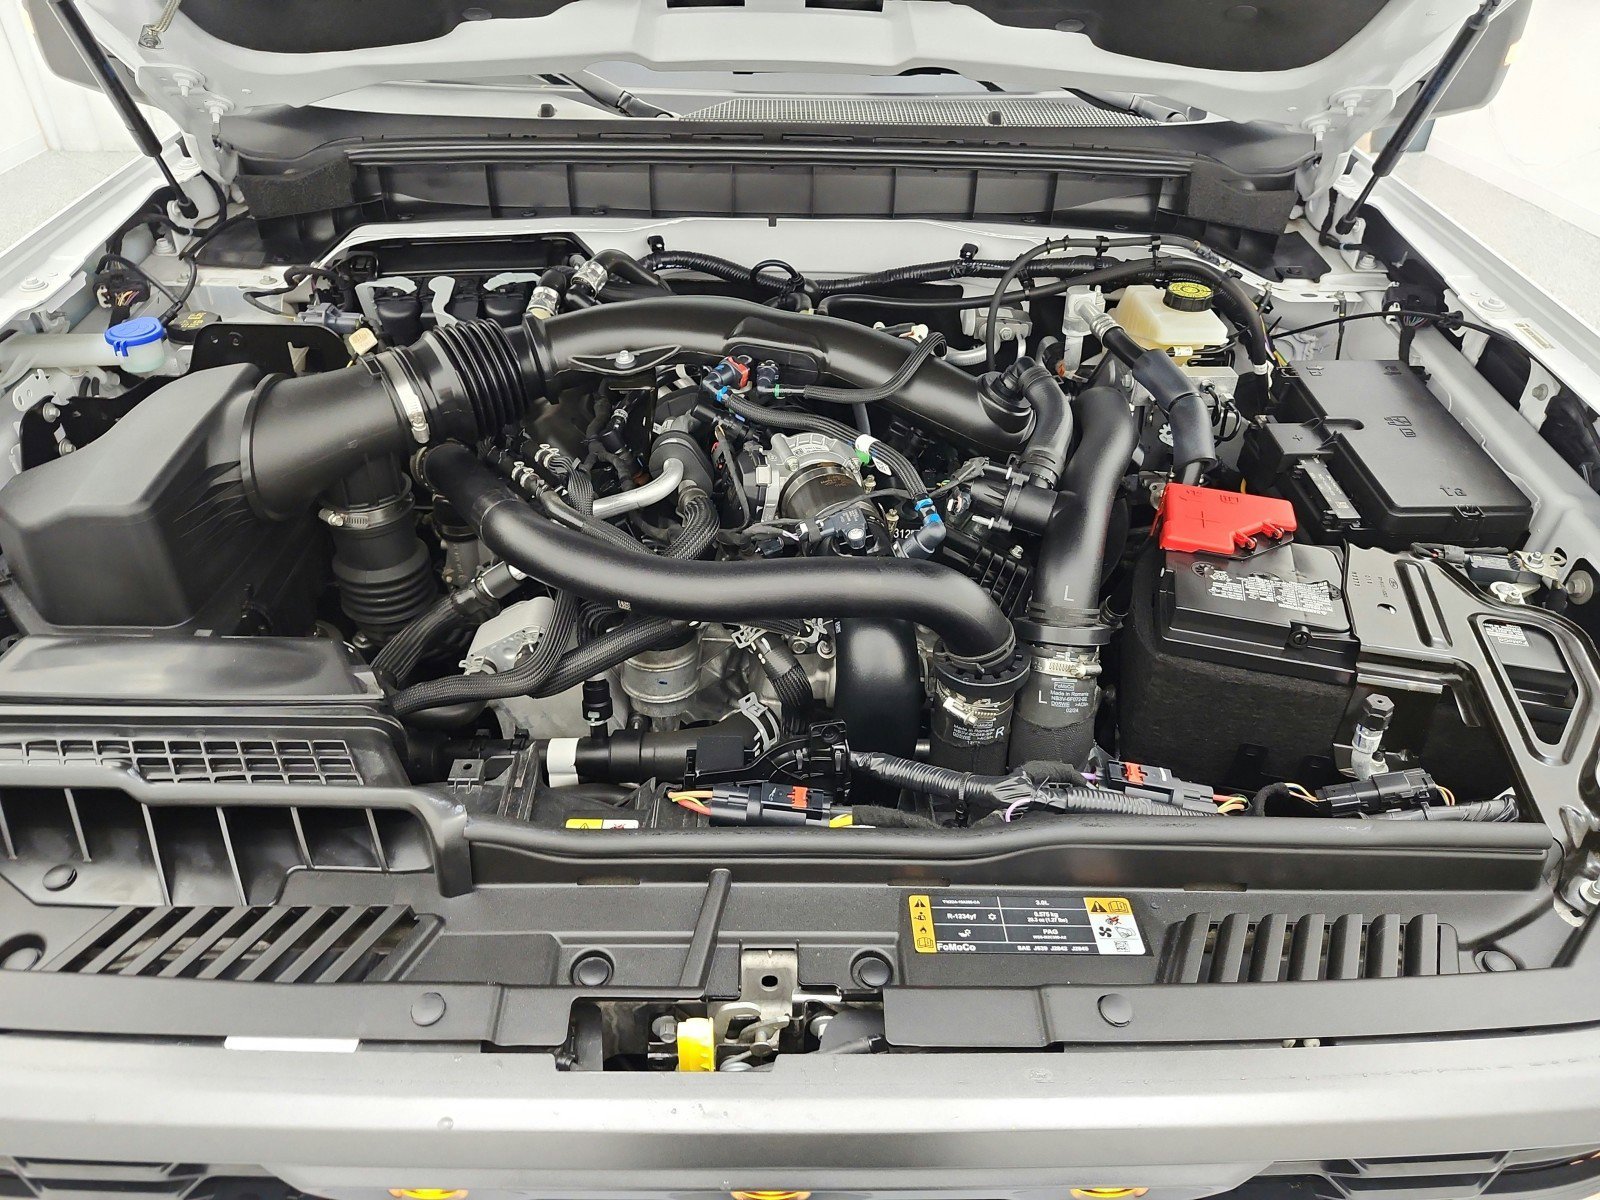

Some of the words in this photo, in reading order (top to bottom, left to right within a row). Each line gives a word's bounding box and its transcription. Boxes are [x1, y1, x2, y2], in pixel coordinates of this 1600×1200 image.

[1063, 585, 1074, 602] L
[1038, 690, 1048, 704] L
[994, 726, 1005, 739] R
[946, 912, 977, 921] R-1234yf
[1050, 911, 1059, 919] kg
[936, 942, 977, 952] FoMoCo
